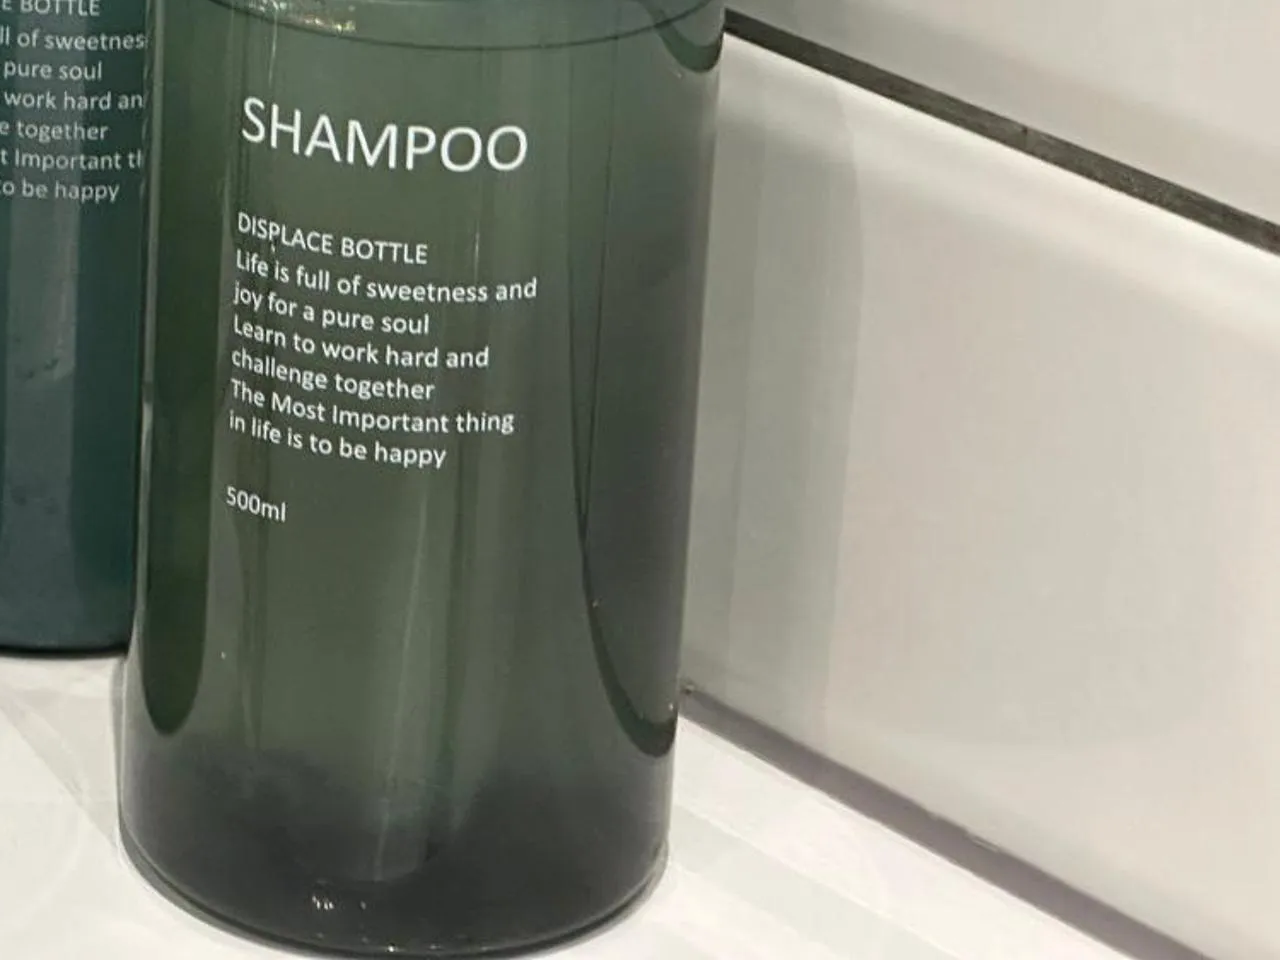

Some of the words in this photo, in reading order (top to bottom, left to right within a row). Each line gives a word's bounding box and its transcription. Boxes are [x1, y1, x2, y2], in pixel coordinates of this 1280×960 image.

[17, 29, 40, 48] of
[44, 33, 145, 51] sweetnes
[3, 60, 53, 80] pure
[58, 60, 103, 81] soul
[4, 86, 57, 110] work
[64, 87, 111, 111] hard
[118, 92, 144, 110] an
[17, 119, 109, 144] together
[241, 95, 529, 173] SHAMPOO
[15, 149, 121, 174] Important
[22, 177, 48, 200] be
[55, 180, 120, 204] happy
[237, 212, 333, 255] DISPLACE
[341, 238, 428, 265] BOTTLE
[236, 248, 269, 278] Life
[274, 260, 290, 282] is
[296, 266, 330, 292] full
[337, 274, 362, 296] of
[366, 281, 489, 302] sweetness
[495, 277, 537, 299] and
[233, 281, 263, 312] joy
[268, 290, 297, 316] for
[303, 303, 315, 322] a
[322, 308, 375, 333] pure
[381, 311, 430, 335] soul
[234, 315, 287, 348] Learn
[293, 329, 315, 354] to
[322, 339, 379, 365] work
[386, 344, 439, 369] hard
[446, 346, 490, 368] and
[231, 349, 328, 392] challenge
[335, 372, 435, 402] together
[231, 378, 266, 407] The
[271, 392, 326, 423] Most
[333, 404, 449, 435] Important
[456, 410, 515, 435] thing
[229, 411, 245, 434] in
[251, 417, 281, 446] life
[287, 429, 303, 449] is
[309, 433, 332, 456] to
[339, 436, 367, 460] be
[375, 443, 447, 470] happy
[225, 485, 287, 523] 500ml
